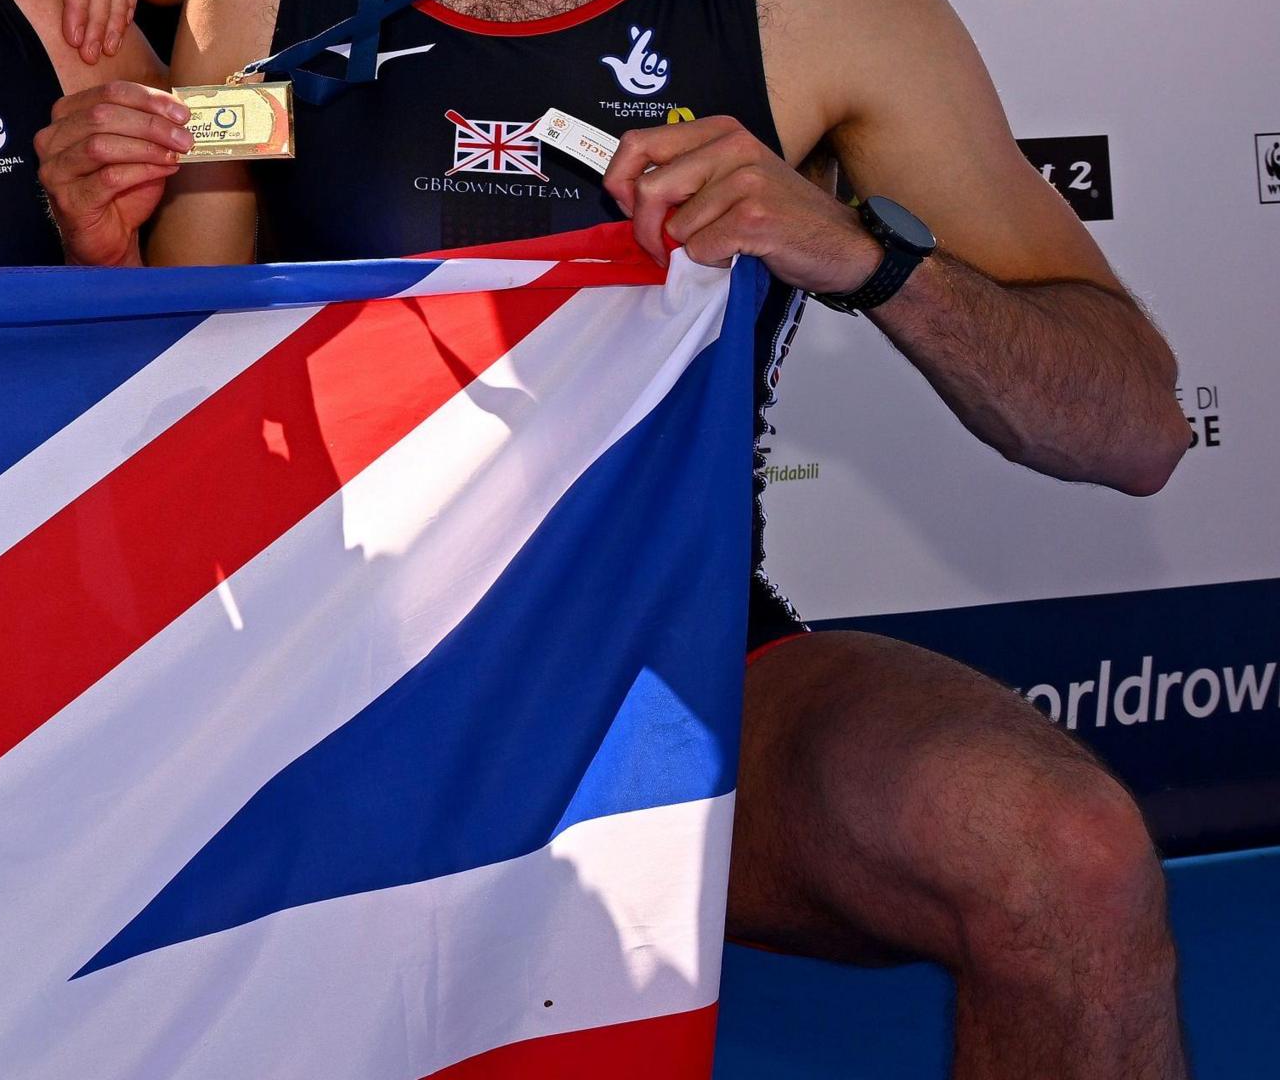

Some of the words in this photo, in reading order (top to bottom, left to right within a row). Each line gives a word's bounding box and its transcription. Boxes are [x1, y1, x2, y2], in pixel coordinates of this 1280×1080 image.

[599, 101, 621, 109] THE
[615, 109, 664, 118] LOTTERY
[1068, 161, 1092, 190] 2
[1197, 386, 1218, 409] DI
